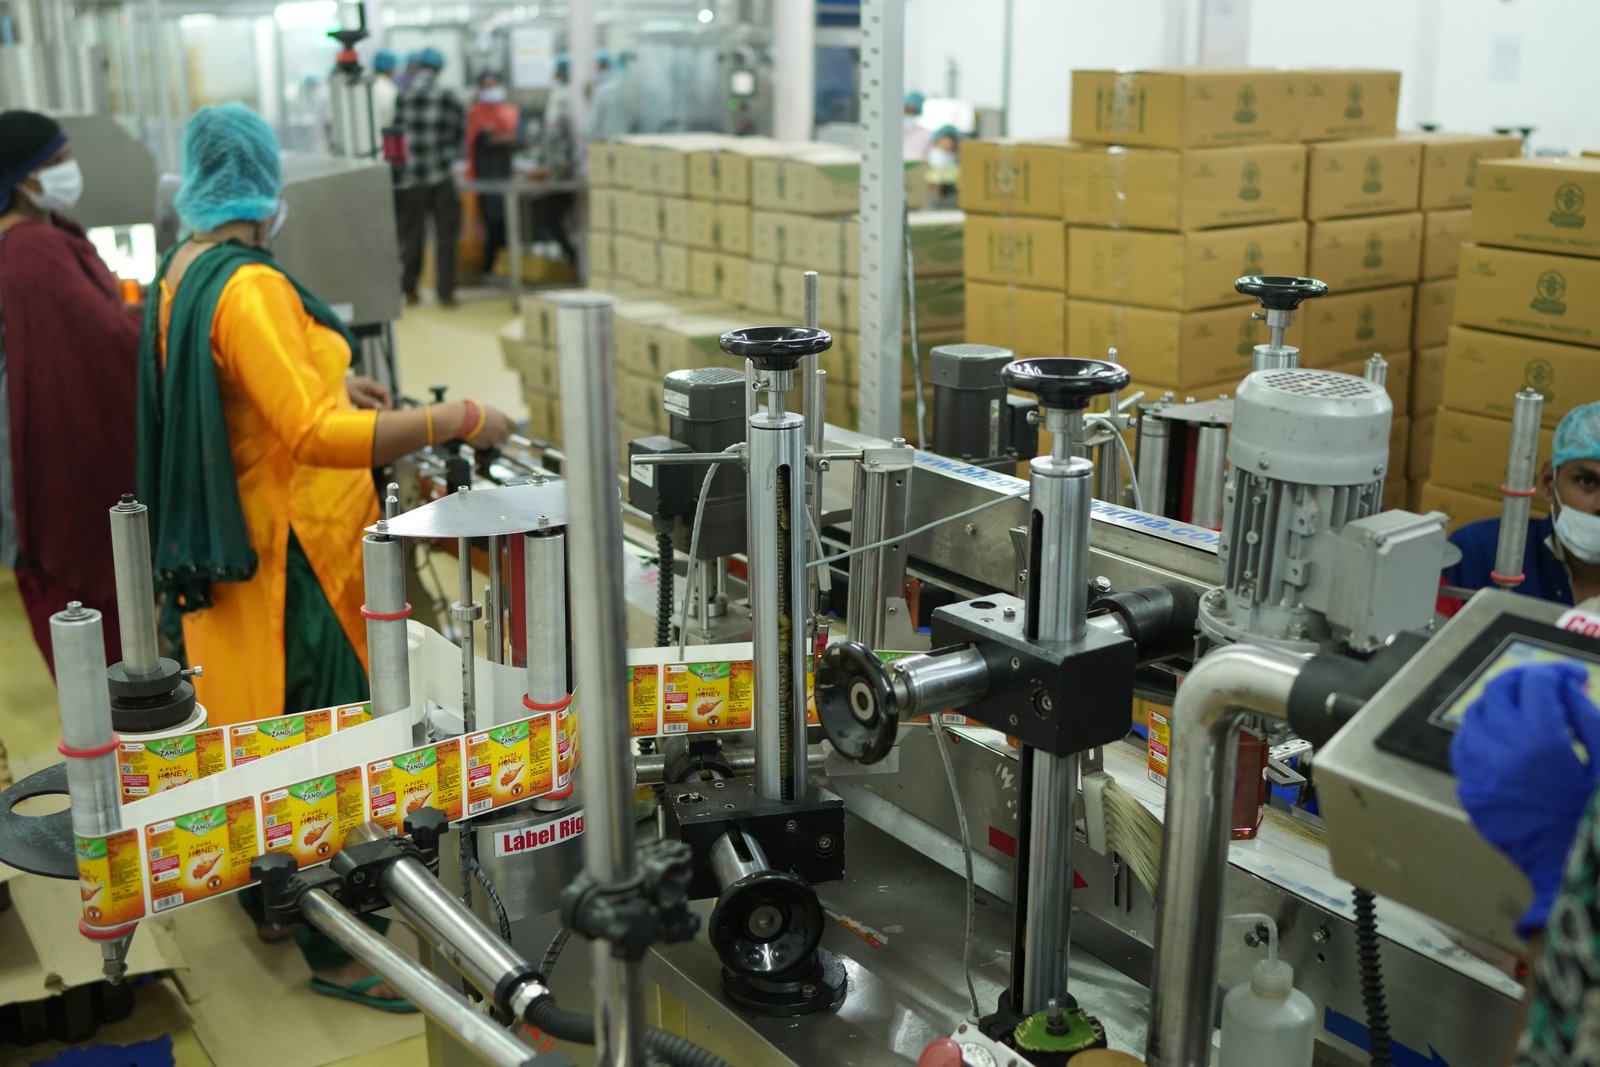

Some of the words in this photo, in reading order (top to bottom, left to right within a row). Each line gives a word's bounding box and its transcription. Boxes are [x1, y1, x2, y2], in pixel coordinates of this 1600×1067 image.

[271, 729, 294, 738] ZANDU
[500, 735, 520, 745] ZANDU
[160, 748, 184, 757] ZANDU
[405, 761, 426, 772] ZANDU
[498, 755, 522, 768] HONEY
[157, 768, 188, 781] HONEY
[403, 782, 430, 796] HONEY
[302, 790, 325, 801] ZANDU
[300, 811, 329, 826] HONEY
[190, 821, 216, 833] ZANDU
[503, 825, 555, 853] Label
[188, 843, 220, 859] HONEY
